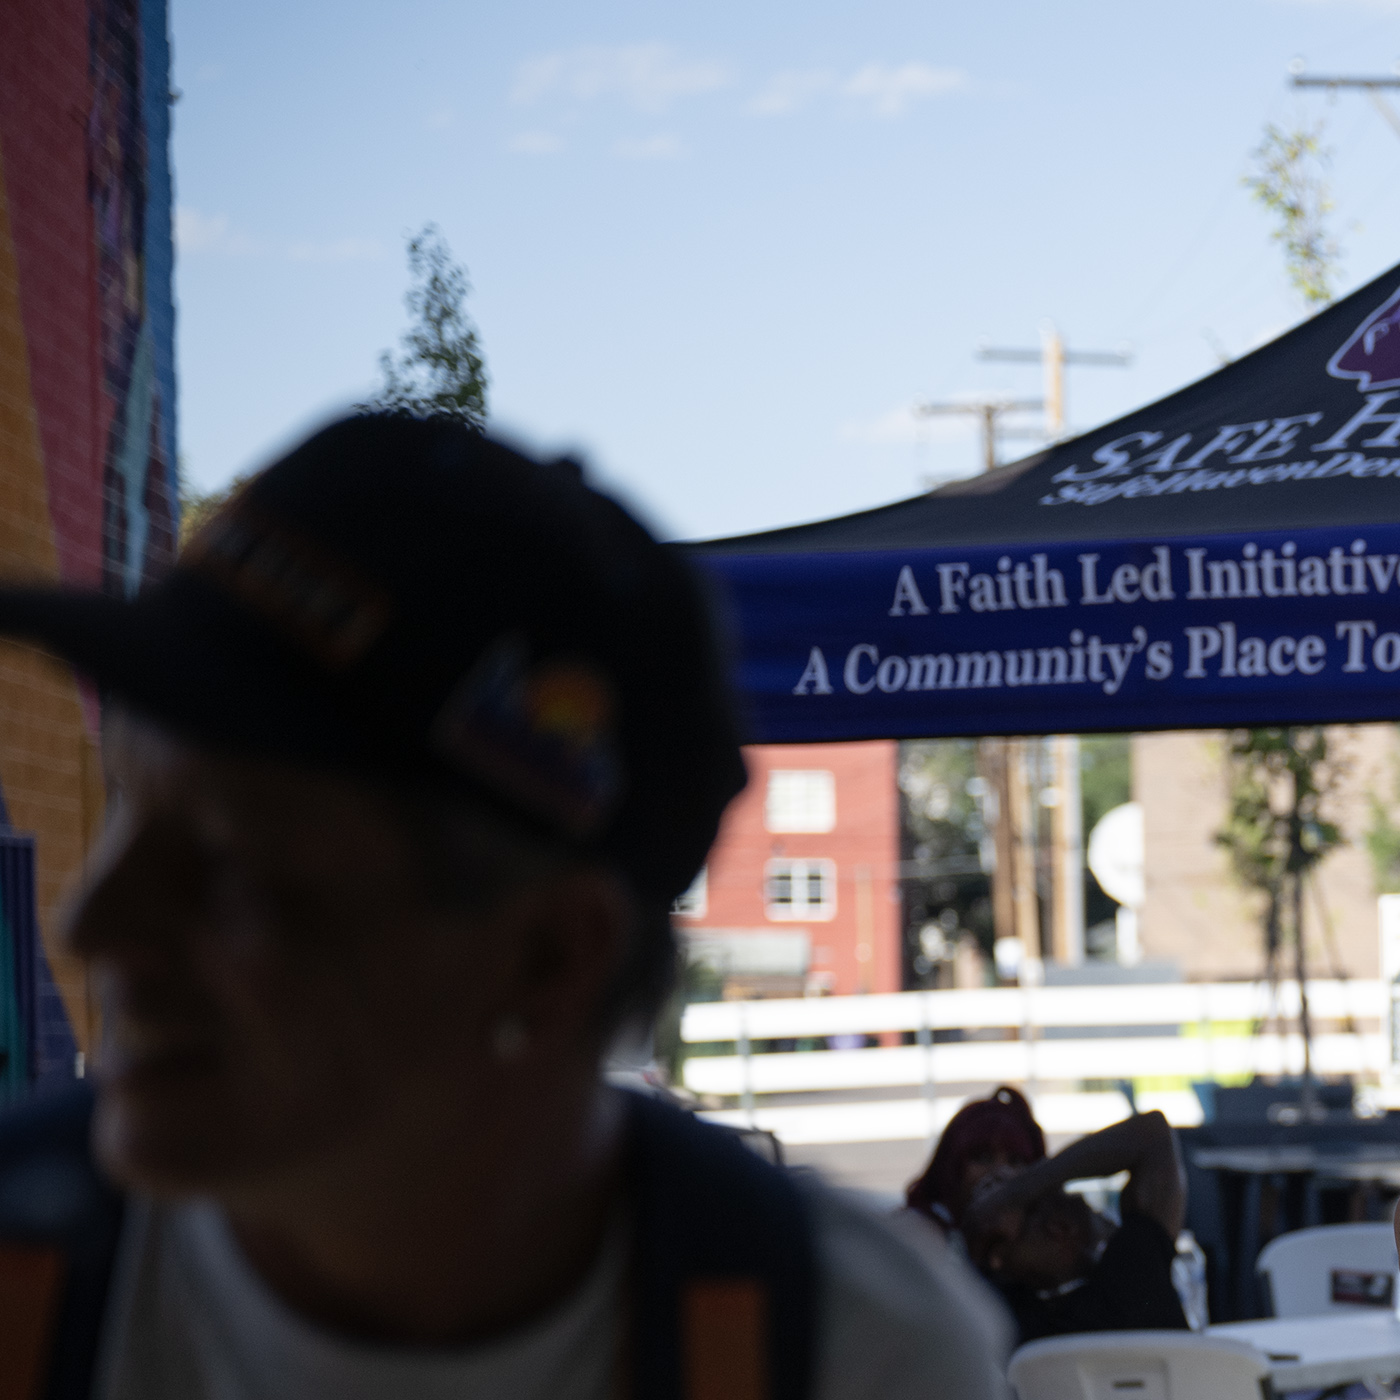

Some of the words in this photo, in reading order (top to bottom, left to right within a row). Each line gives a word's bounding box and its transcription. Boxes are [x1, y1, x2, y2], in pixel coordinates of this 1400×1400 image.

[889, 564, 930, 617] A
[936, 553, 1070, 614] Faith
[1078, 546, 1176, 605] Led
[793, 646, 833, 696] A
[842, 626, 1174, 696] Community's
[1183, 621, 1328, 678] Place
